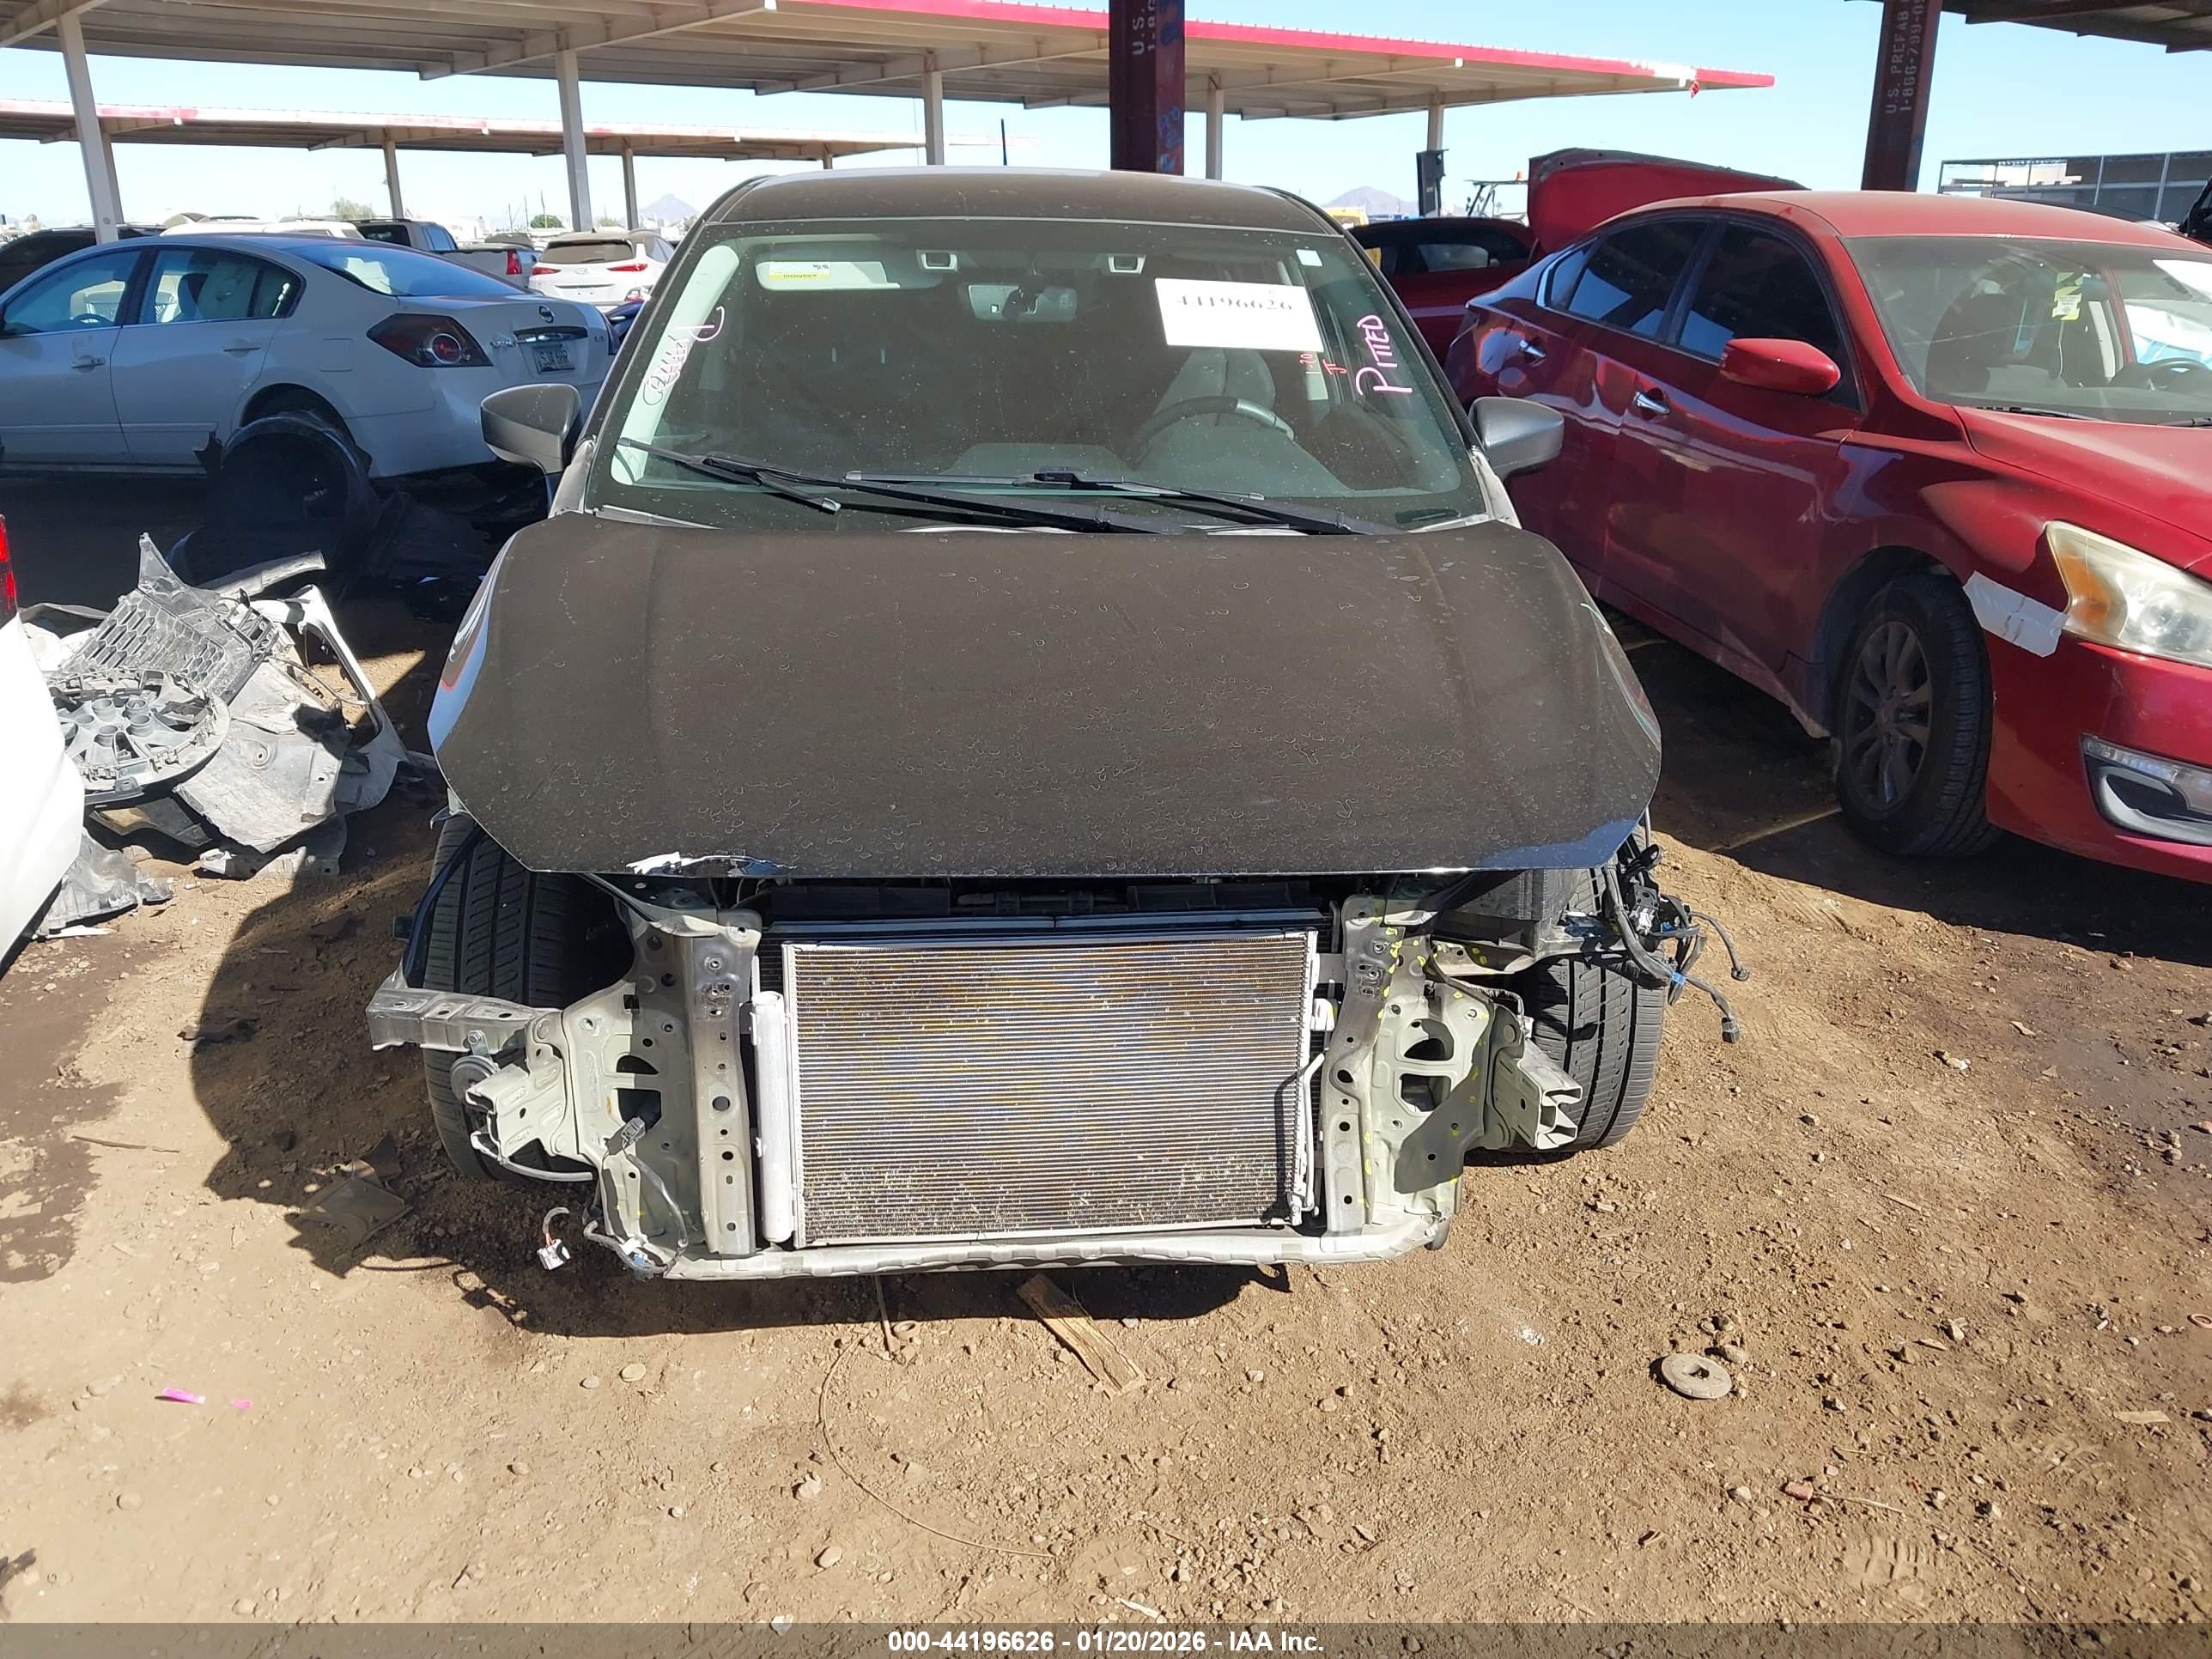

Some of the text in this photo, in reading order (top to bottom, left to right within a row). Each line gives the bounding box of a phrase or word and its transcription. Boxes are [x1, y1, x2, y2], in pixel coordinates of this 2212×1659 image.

[1132, 8, 1146, 56] U.S.
[1885, 82, 1900, 114] U.S.
[1355, 314, 1413, 396] PITTED
